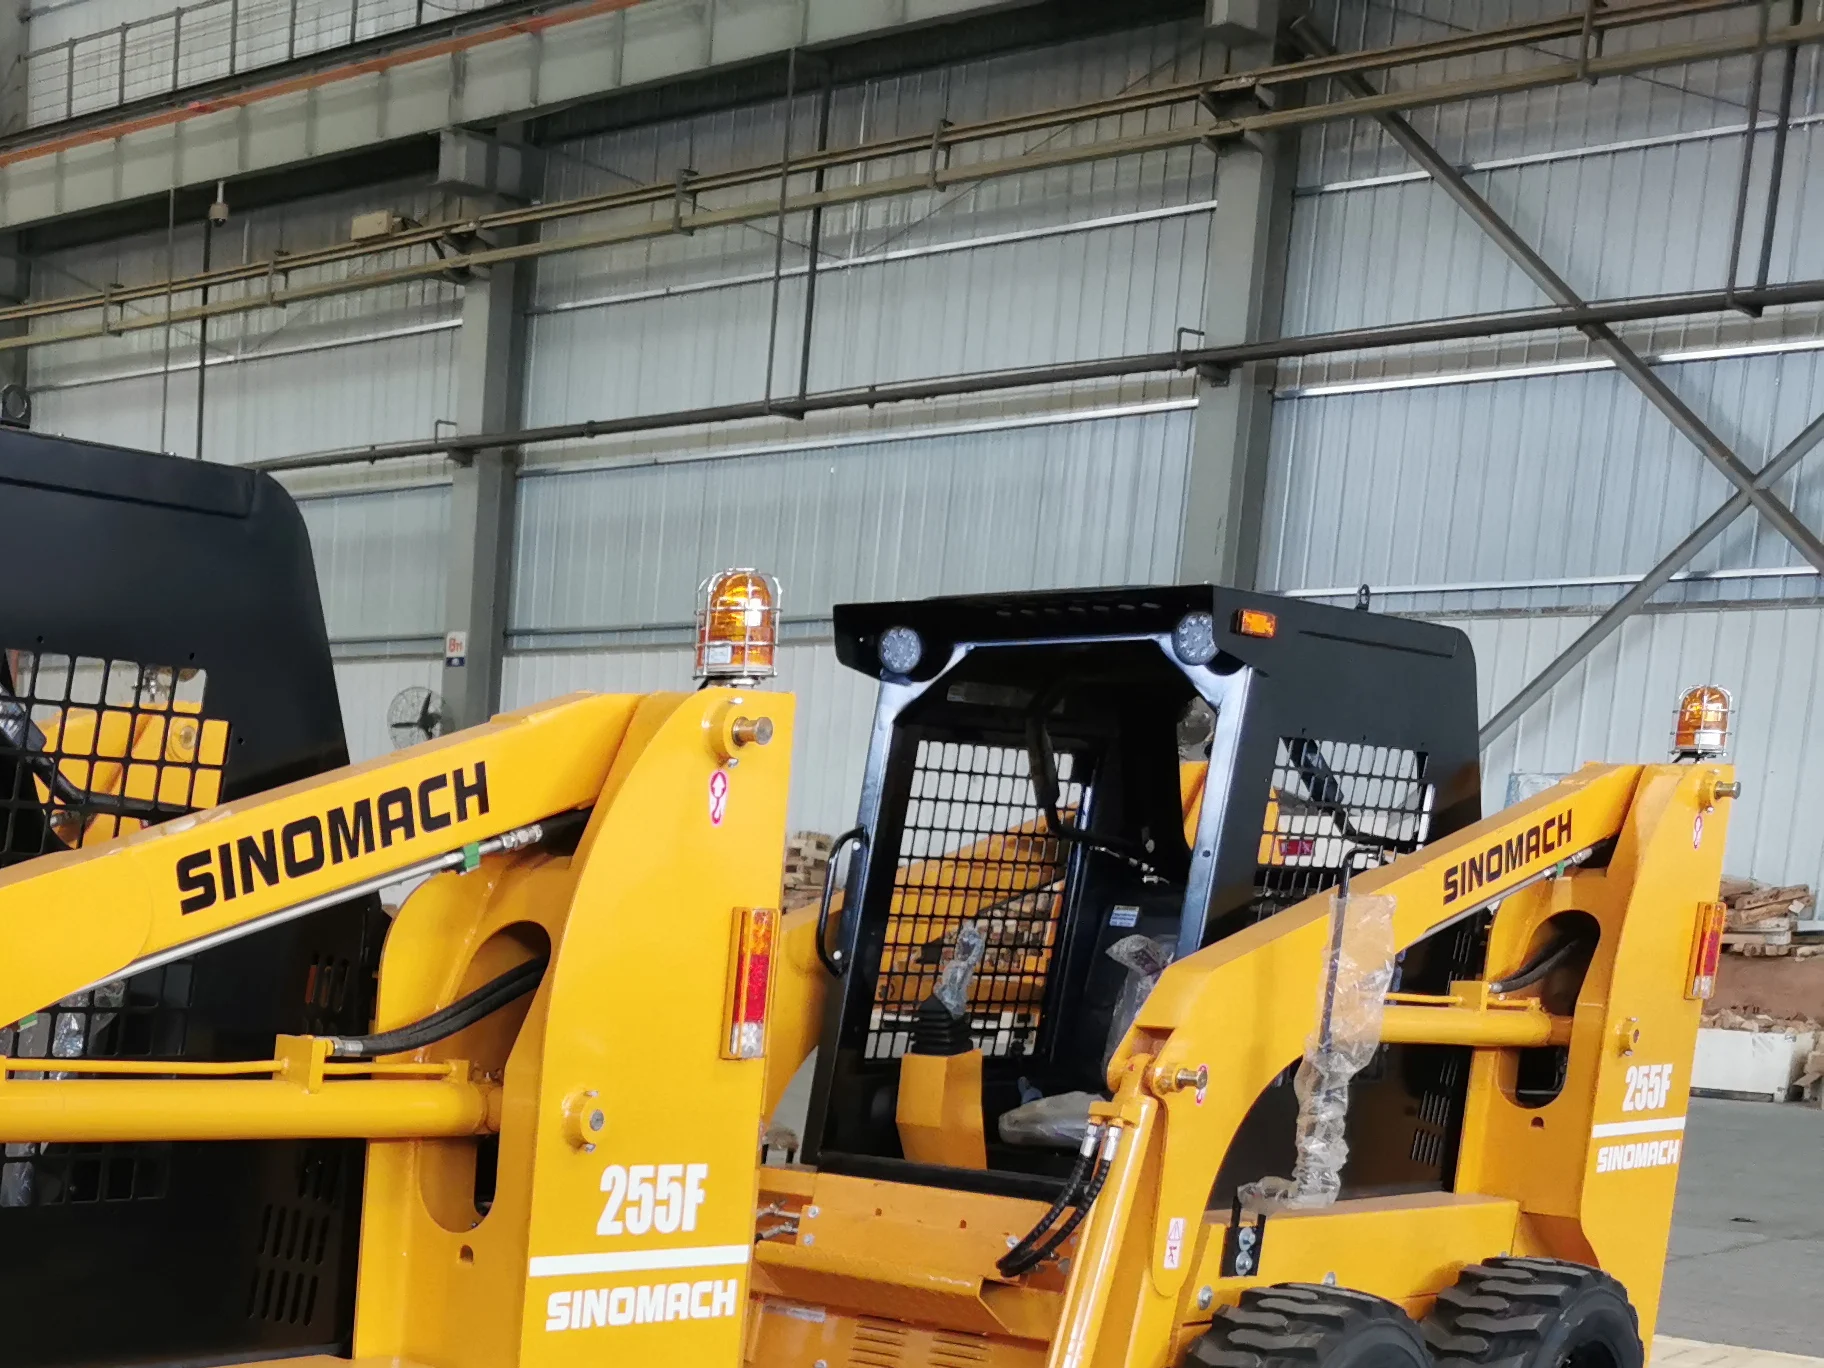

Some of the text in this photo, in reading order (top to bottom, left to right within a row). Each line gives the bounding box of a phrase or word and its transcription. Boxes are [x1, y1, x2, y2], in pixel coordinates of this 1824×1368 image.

[176, 761, 490, 916] SINOMACH
[1443, 808, 1573, 906] SINOMACH
[1622, 1063, 1674, 1112] 255F
[1596, 1139, 1681, 1174] SINOMACH
[596, 1163, 709, 1236] 255F
[545, 1278, 738, 1332] SINOMACH
